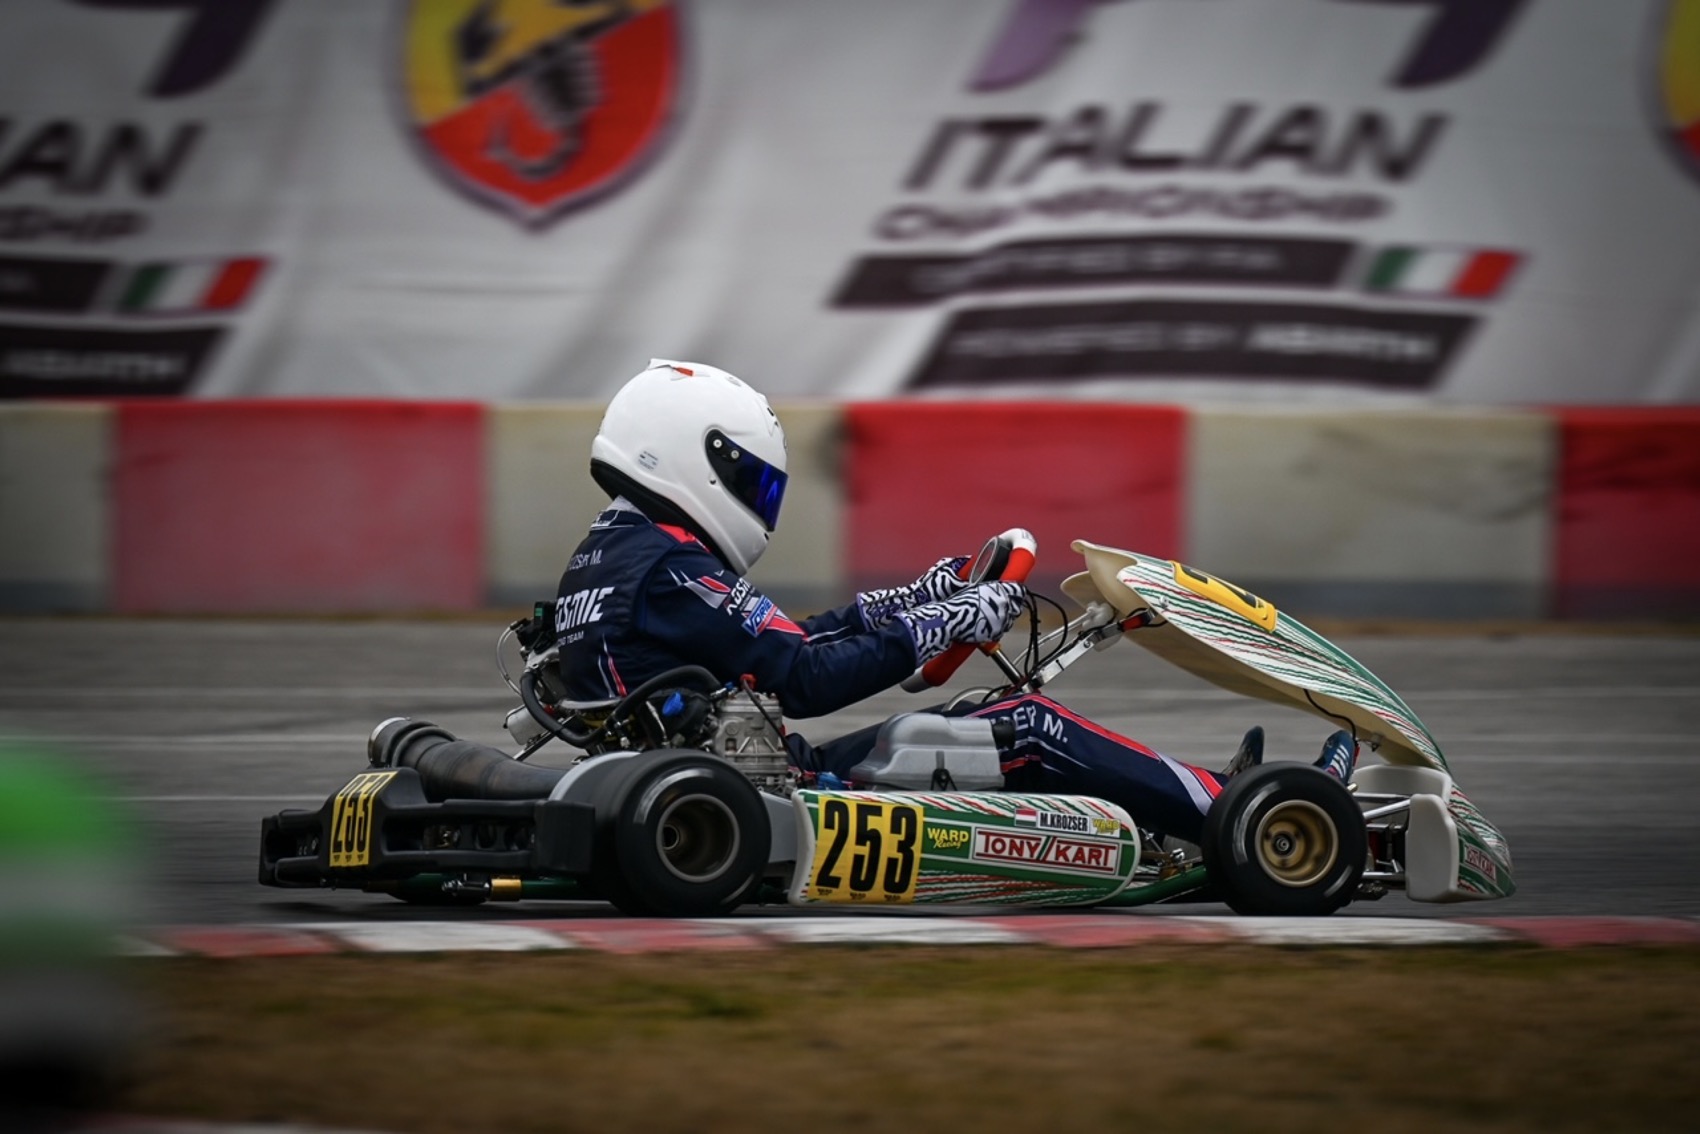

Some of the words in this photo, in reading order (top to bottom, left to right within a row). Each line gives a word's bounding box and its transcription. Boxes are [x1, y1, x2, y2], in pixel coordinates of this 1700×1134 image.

[899, 102, 1450, 190] ITALIAN
[1043, 712, 1068, 743] M.
[927, 828, 969, 843] WARD
[1040, 812, 1088, 832] M.KROZSER
[815, 799, 918, 893] 253
